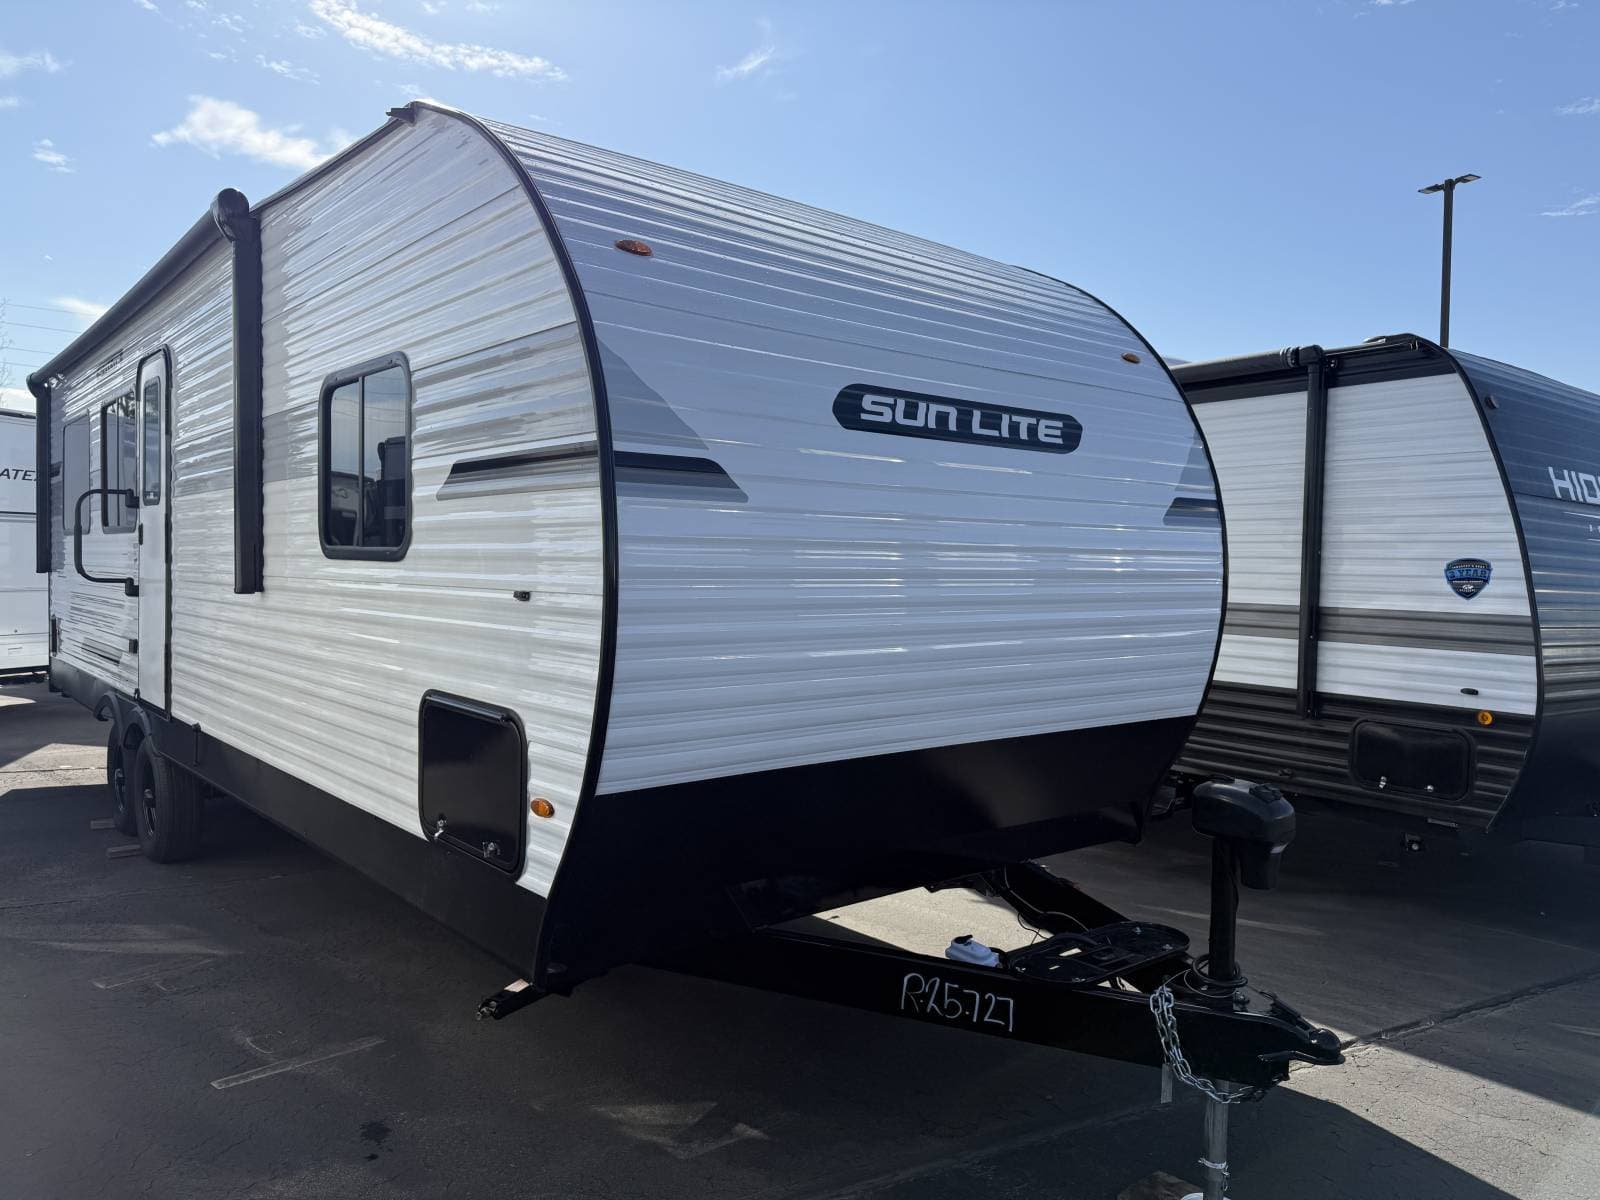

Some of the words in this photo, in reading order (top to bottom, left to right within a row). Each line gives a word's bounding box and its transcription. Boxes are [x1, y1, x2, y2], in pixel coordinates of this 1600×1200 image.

[860, 394, 957, 431] SUN
[972, 410, 1064, 444] LITE
[0, 468, 37, 481] ATE
[1548, 466, 1600, 505] HID
[1457, 569, 1487, 579] YEAR
